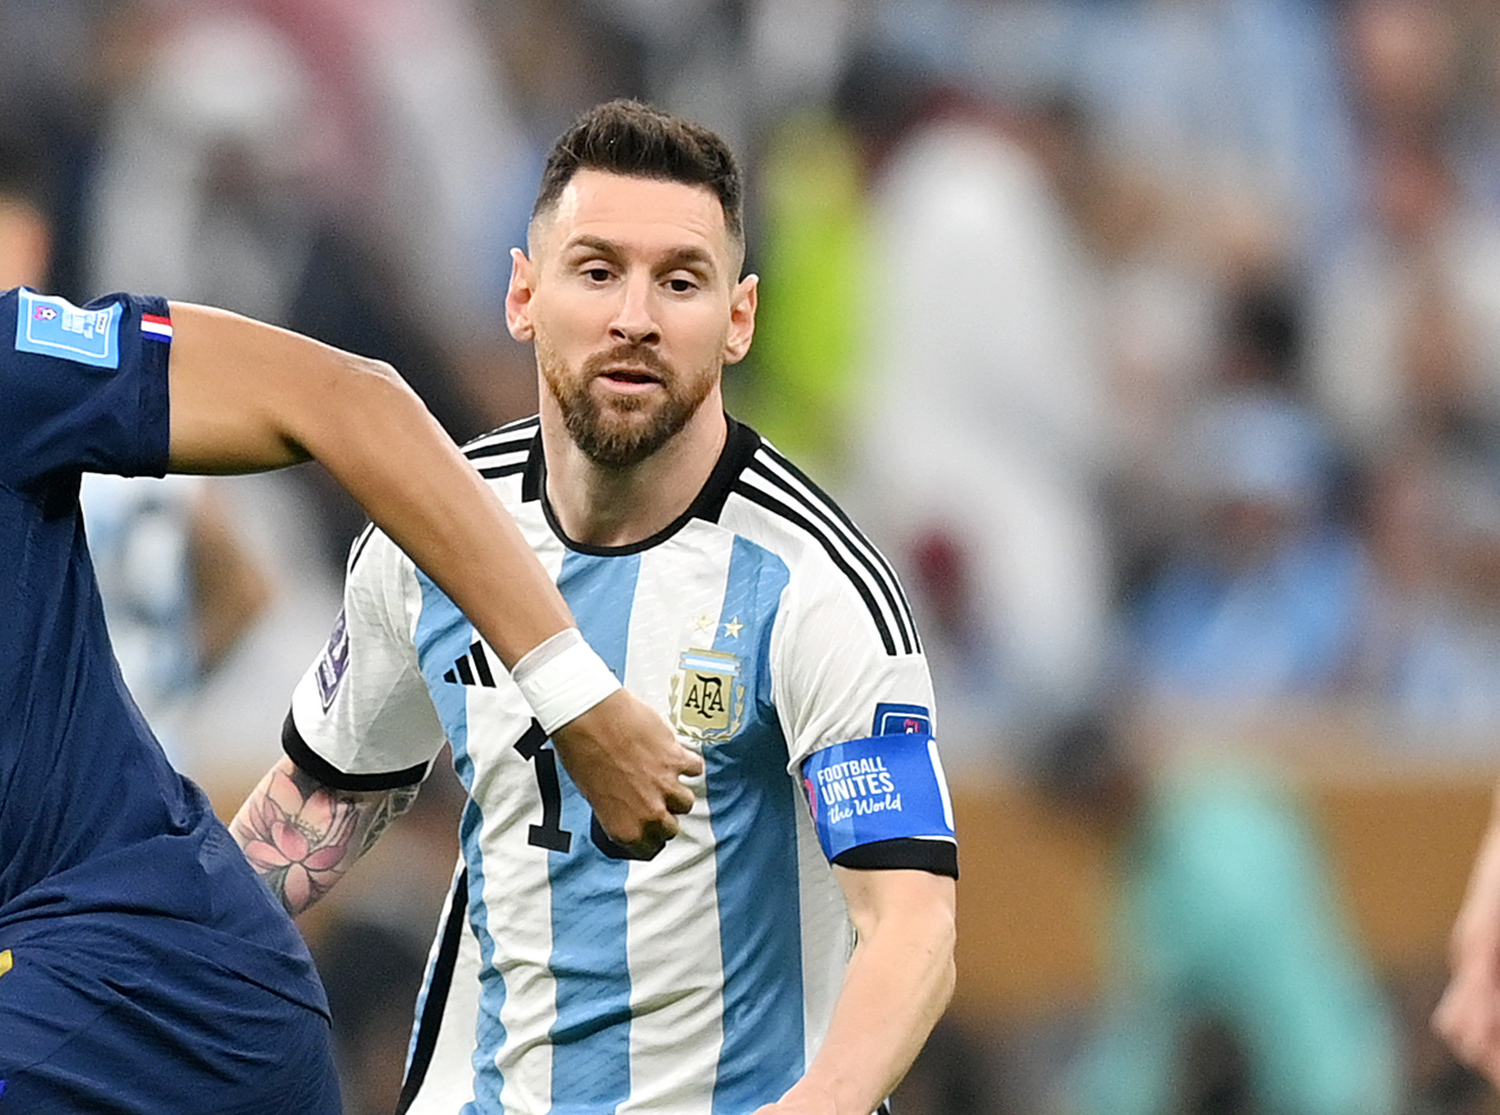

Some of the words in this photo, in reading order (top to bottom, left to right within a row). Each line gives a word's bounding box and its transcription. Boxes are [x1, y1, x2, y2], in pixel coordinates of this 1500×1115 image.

[684, 673, 725, 719] AFA
[817, 755, 888, 787] FOOTBALL
[820, 772, 895, 806] UNITES
[827, 804, 854, 825] the
[853, 793, 903, 816] World
